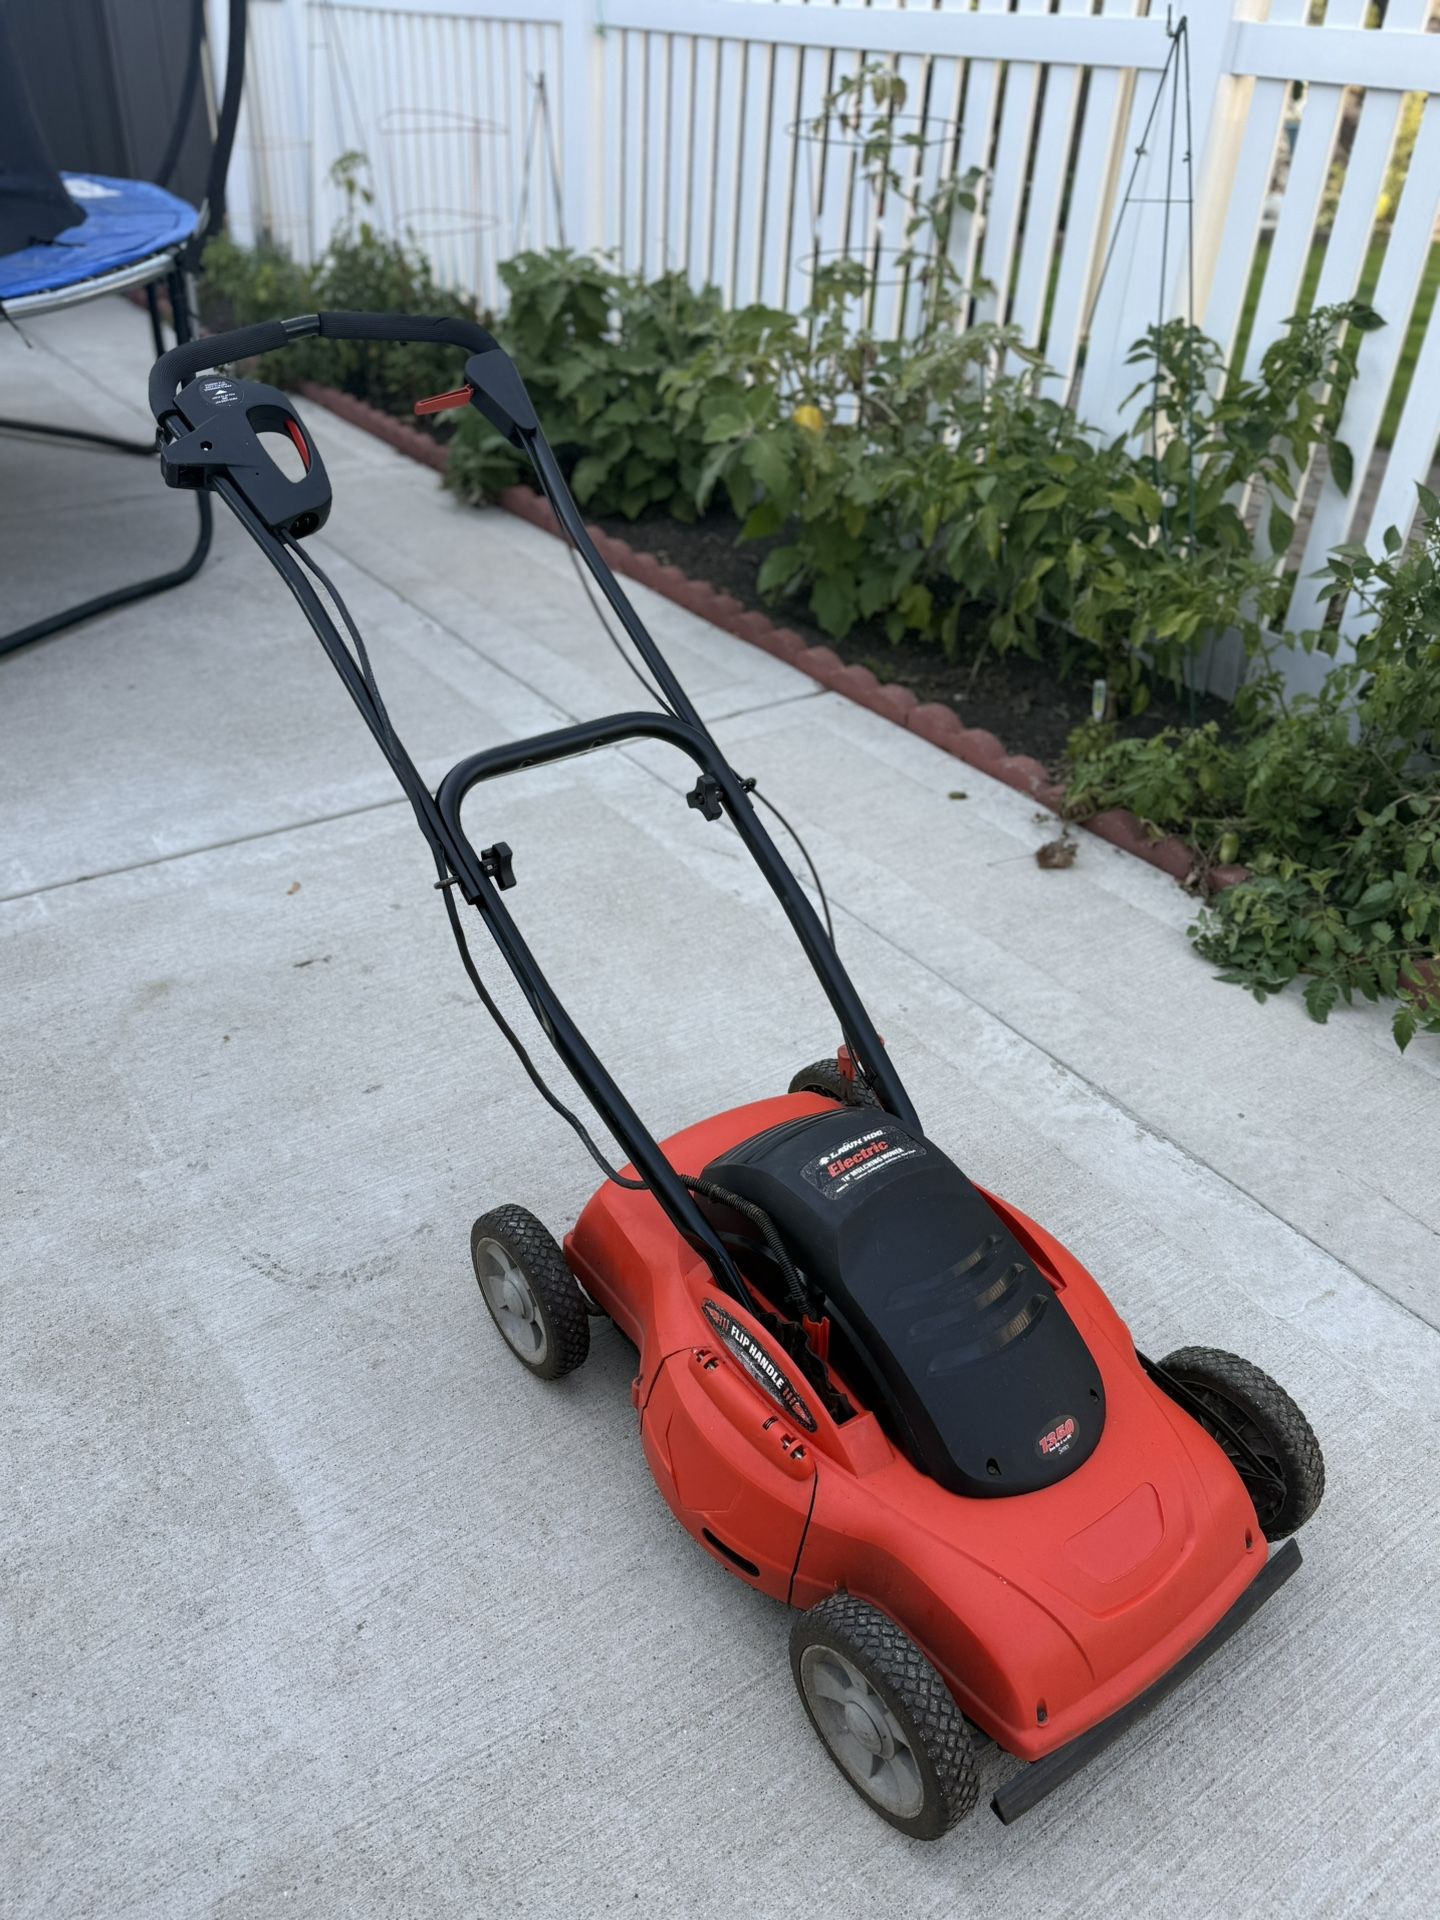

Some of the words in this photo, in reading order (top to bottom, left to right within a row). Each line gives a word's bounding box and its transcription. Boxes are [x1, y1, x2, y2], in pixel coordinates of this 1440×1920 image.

[827, 1140, 889, 1178] Electric
[829, 1138, 862, 1159] LAWN
[731, 1325, 750, 1347] FLIP
[748, 1344, 784, 1389] HANDLE
